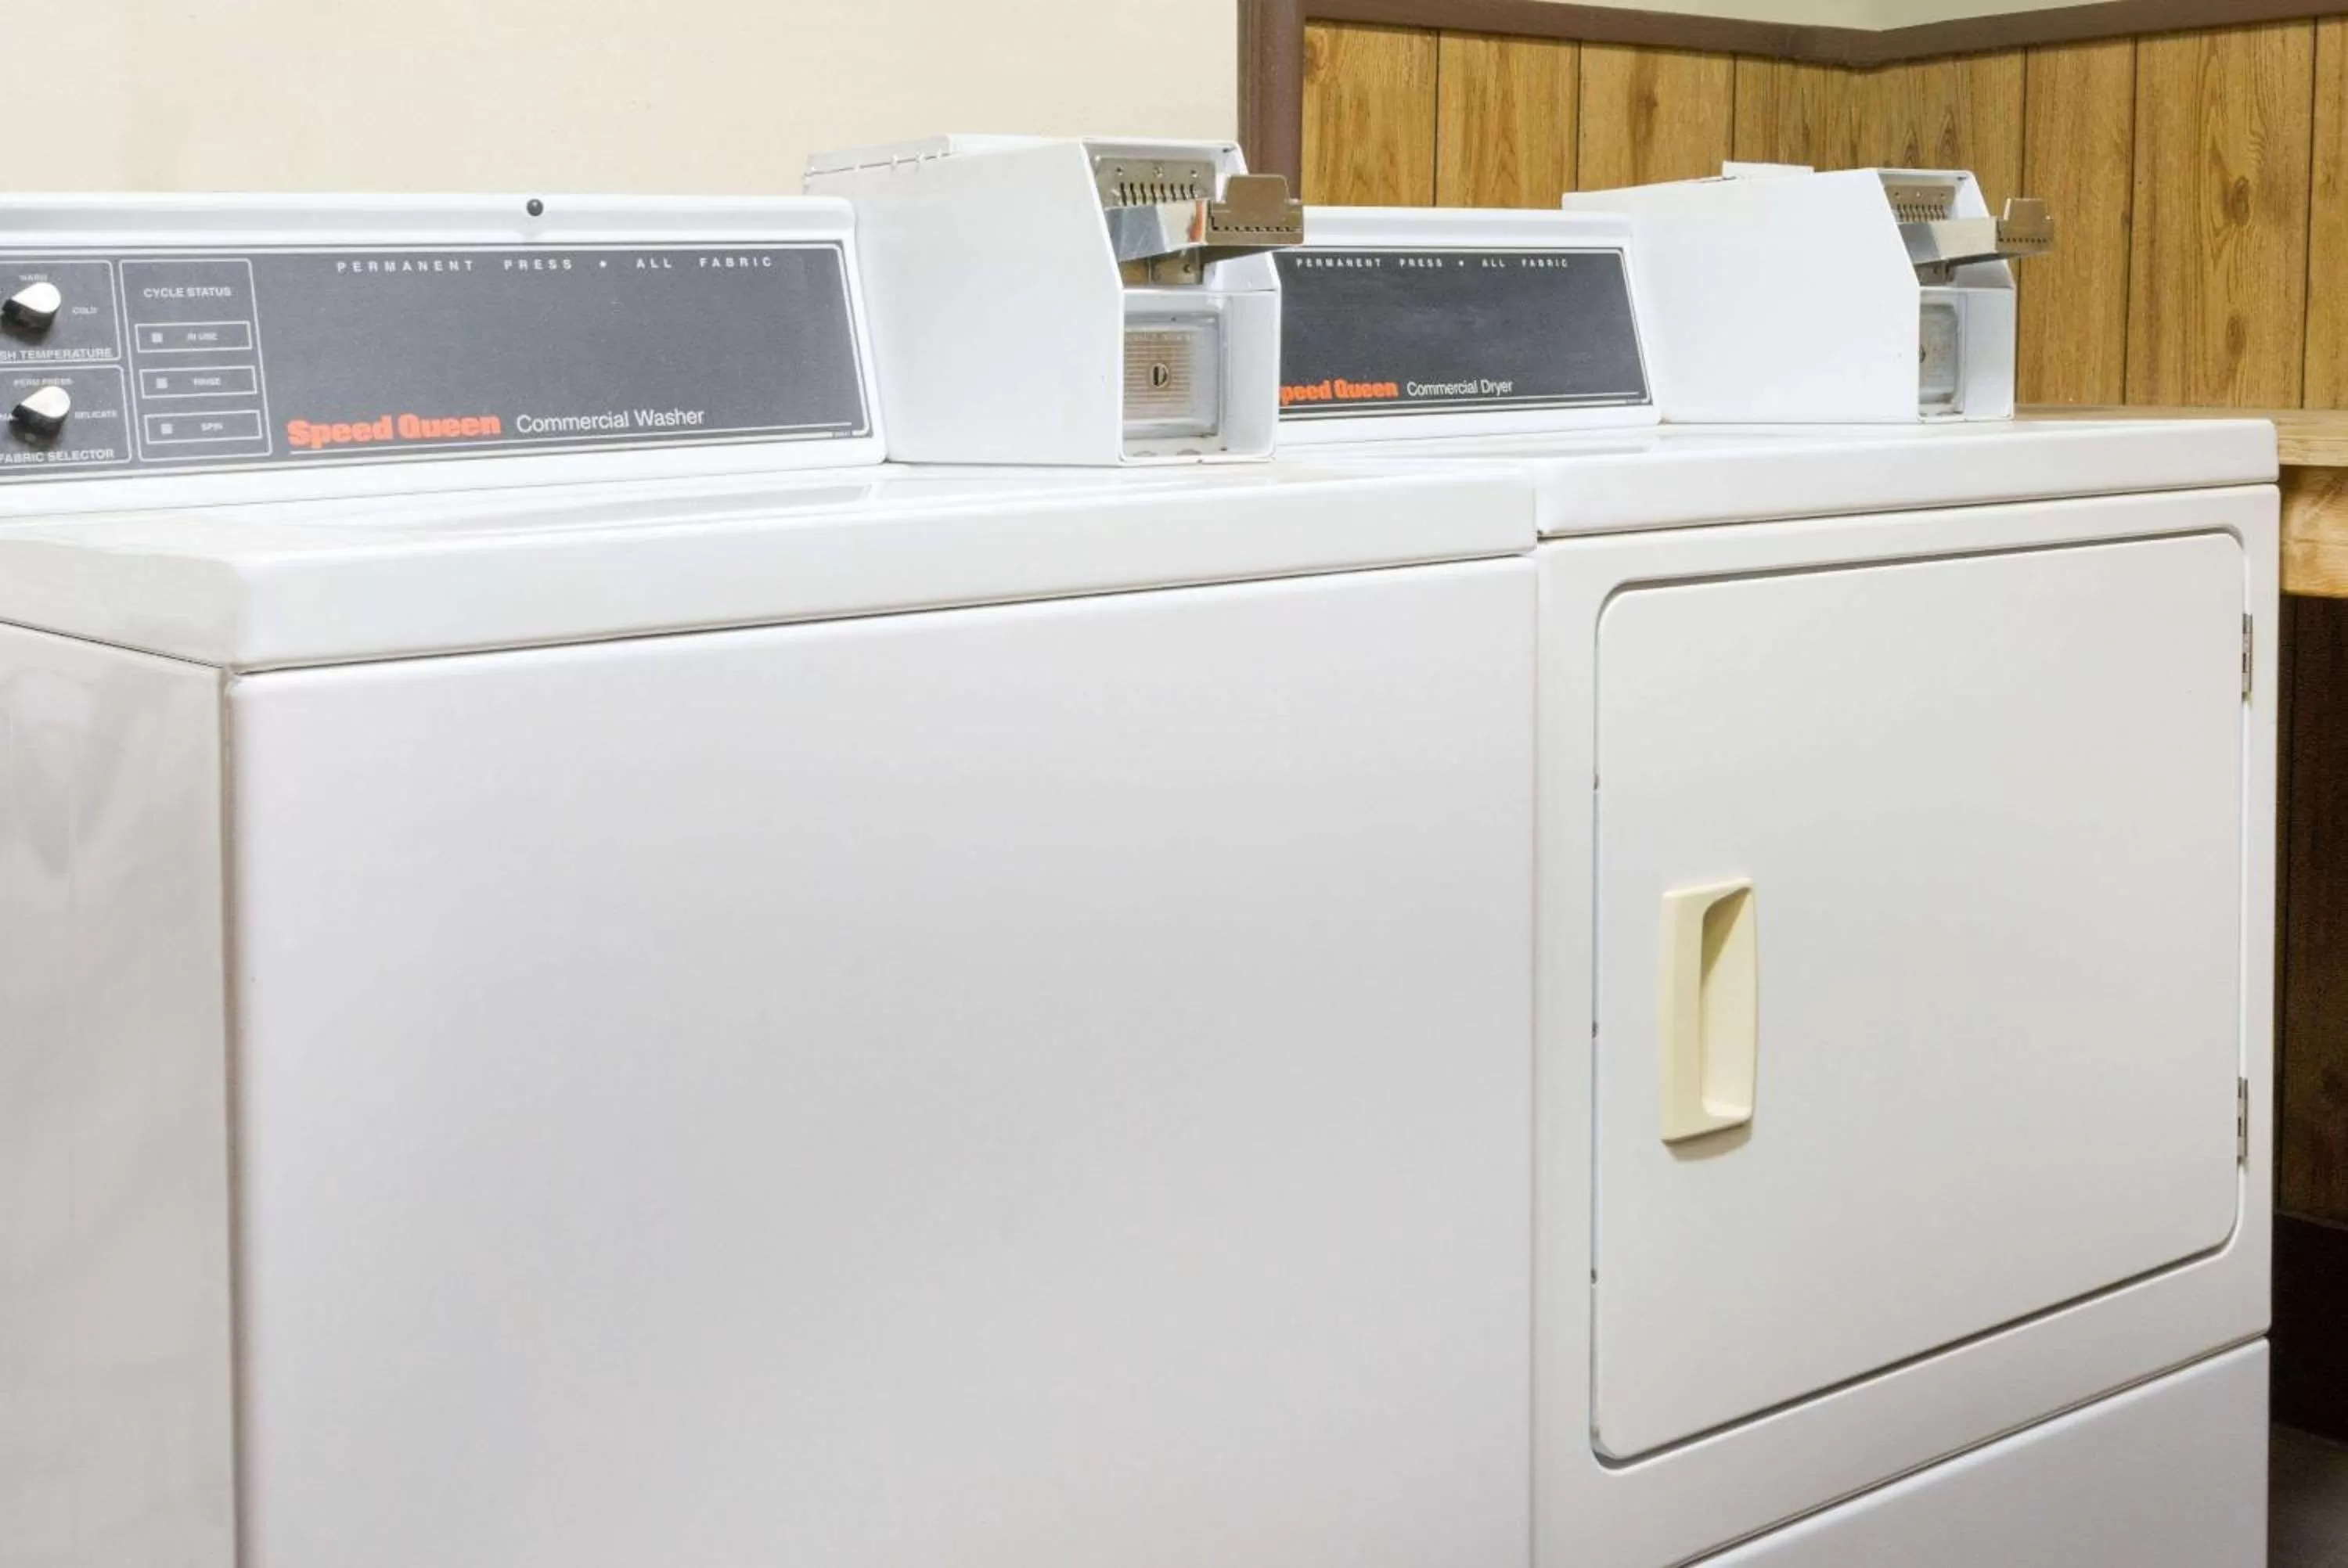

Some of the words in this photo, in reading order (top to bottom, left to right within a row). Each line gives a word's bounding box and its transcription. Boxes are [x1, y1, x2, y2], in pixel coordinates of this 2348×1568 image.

[337, 261, 475, 272] PERMANENT
[504, 259, 573, 271] PRESS
[636, 257, 674, 268] ALL
[699, 256, 772, 268] FABRIC
[1295, 257, 1381, 268] PERMANENT
[1399, 257, 1443, 268] PRESS
[1482, 257, 1506, 268] ALL
[1522, 257, 1568, 268] FABRIC
[143, 287, 185, 297] CYCLE
[186, 286, 232, 297] STATUS
[19, 347, 113, 359] TEMPERATURE
[1280, 379, 1331, 405] peed
[1334, 378, 1399, 399] Queen
[1406, 379, 1478, 397] Commercial
[1480, 378, 1513, 396] Dryer
[287, 414, 393, 449] Speed
[397, 412, 502, 439] Queen
[516, 411, 629, 433] Commercial
[633, 408, 704, 426] Washer
[48, 448, 115, 462] SELECTOR
